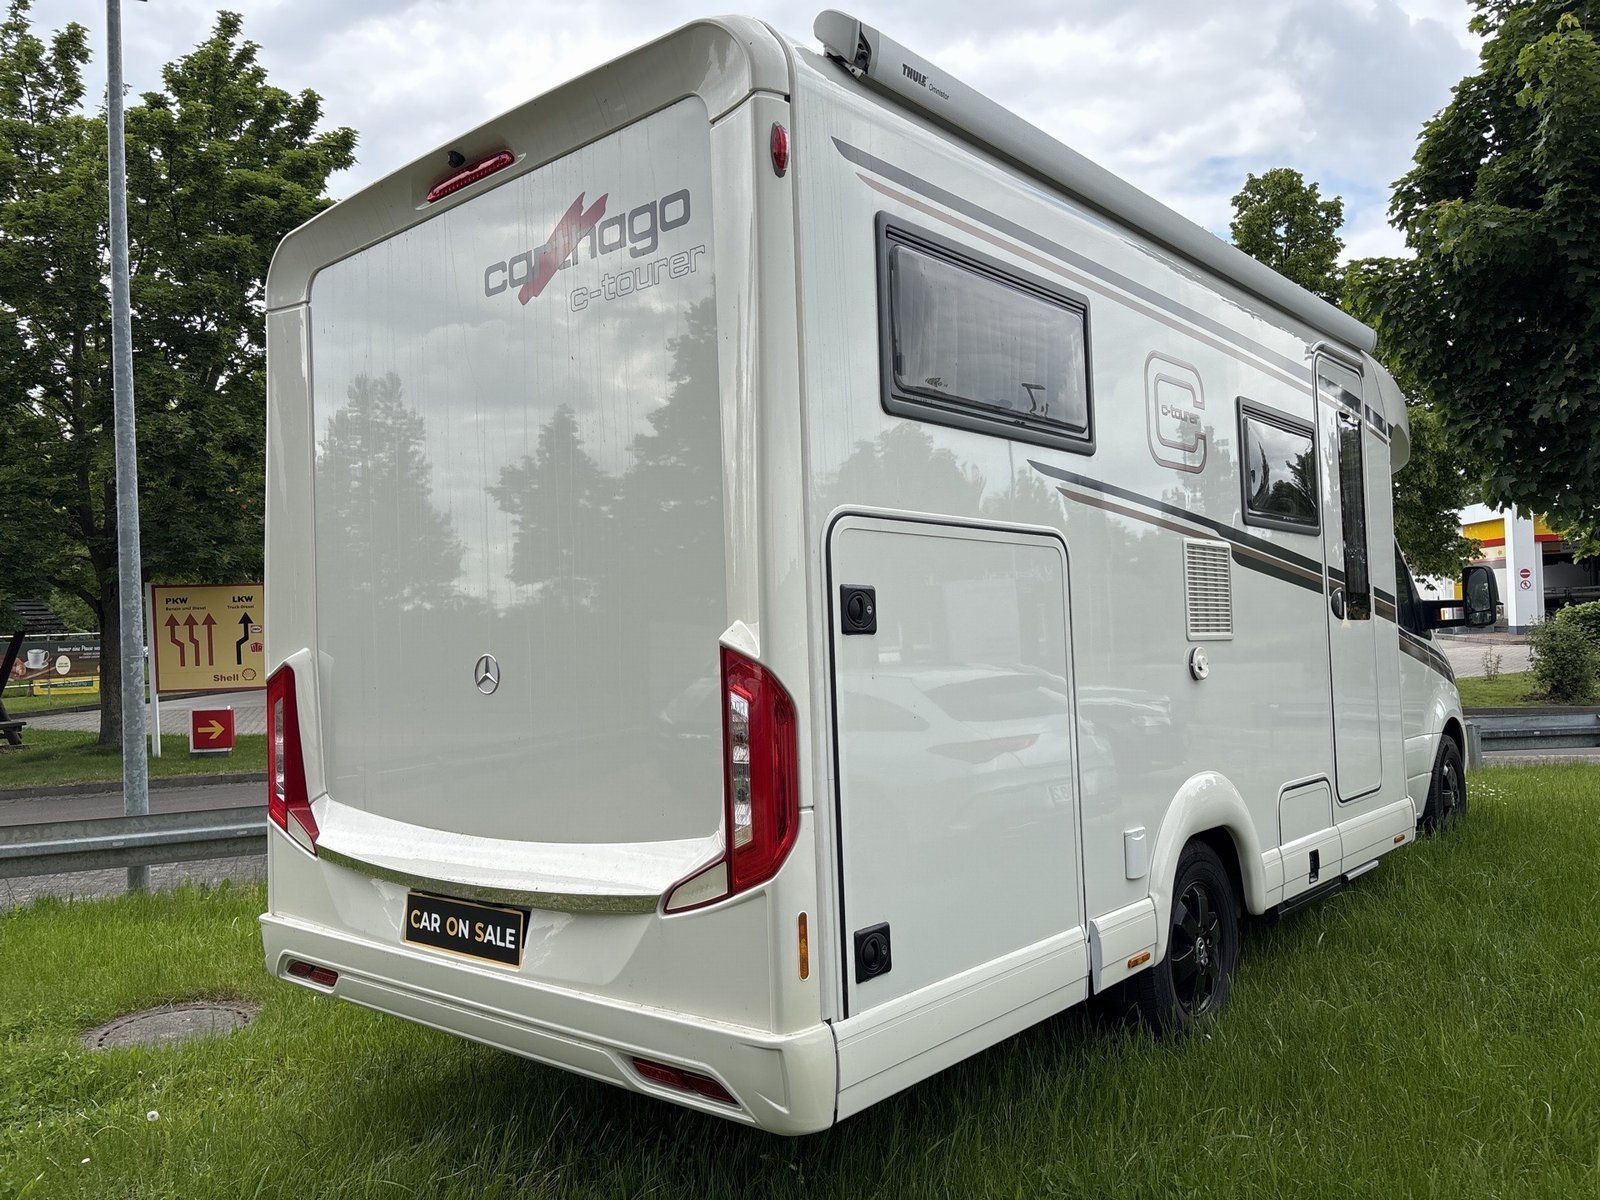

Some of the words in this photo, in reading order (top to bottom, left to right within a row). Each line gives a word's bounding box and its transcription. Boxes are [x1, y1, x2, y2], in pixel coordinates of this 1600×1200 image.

[902, 63, 926, 87] THULE
[569, 244, 705, 312] c-tourer
[165, 597, 188, 605] PKW
[232, 595, 254, 603] LKW
[213, 673, 239, 682] Shell
[410, 909, 440, 933] CAR
[446, 916, 469, 939] ON
[474, 922, 516, 949] SALE
